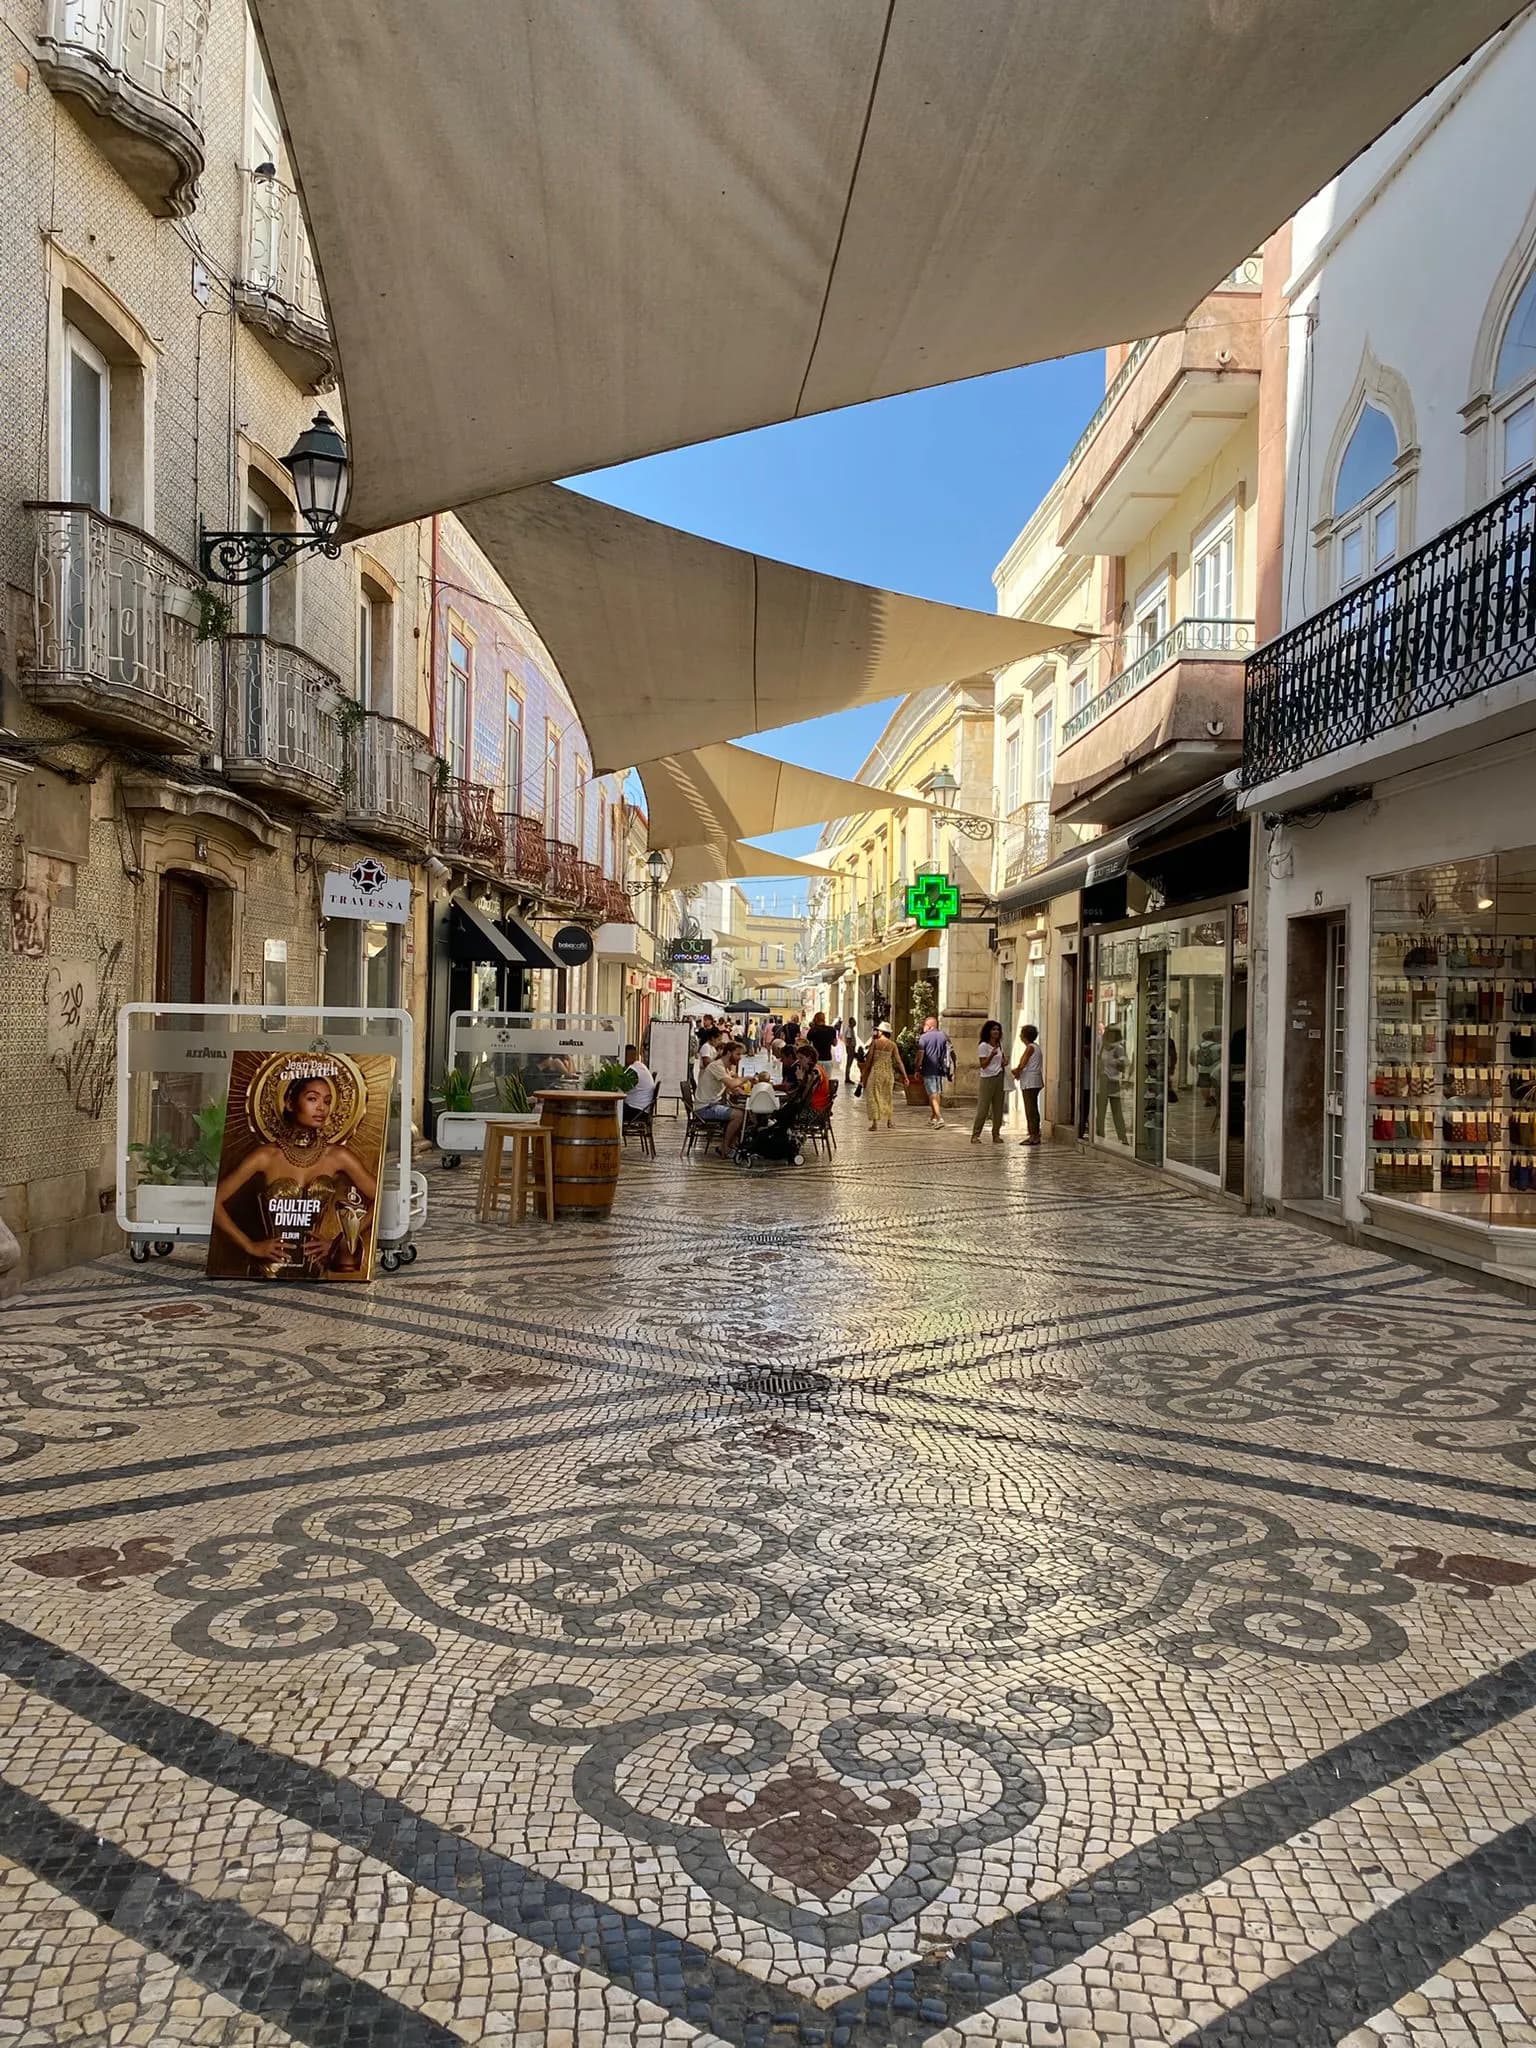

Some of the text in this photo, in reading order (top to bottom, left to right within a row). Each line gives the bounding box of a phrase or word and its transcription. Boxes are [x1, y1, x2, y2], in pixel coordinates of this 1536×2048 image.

[330, 895, 403, 910] TRAVESSA
[285, 1060, 334, 1071] Jean Paul
[280, 1066, 338, 1081] GAULTIER
[269, 1199, 320, 1213] GAULTIER
[275, 1213, 311, 1226] DIVINE
